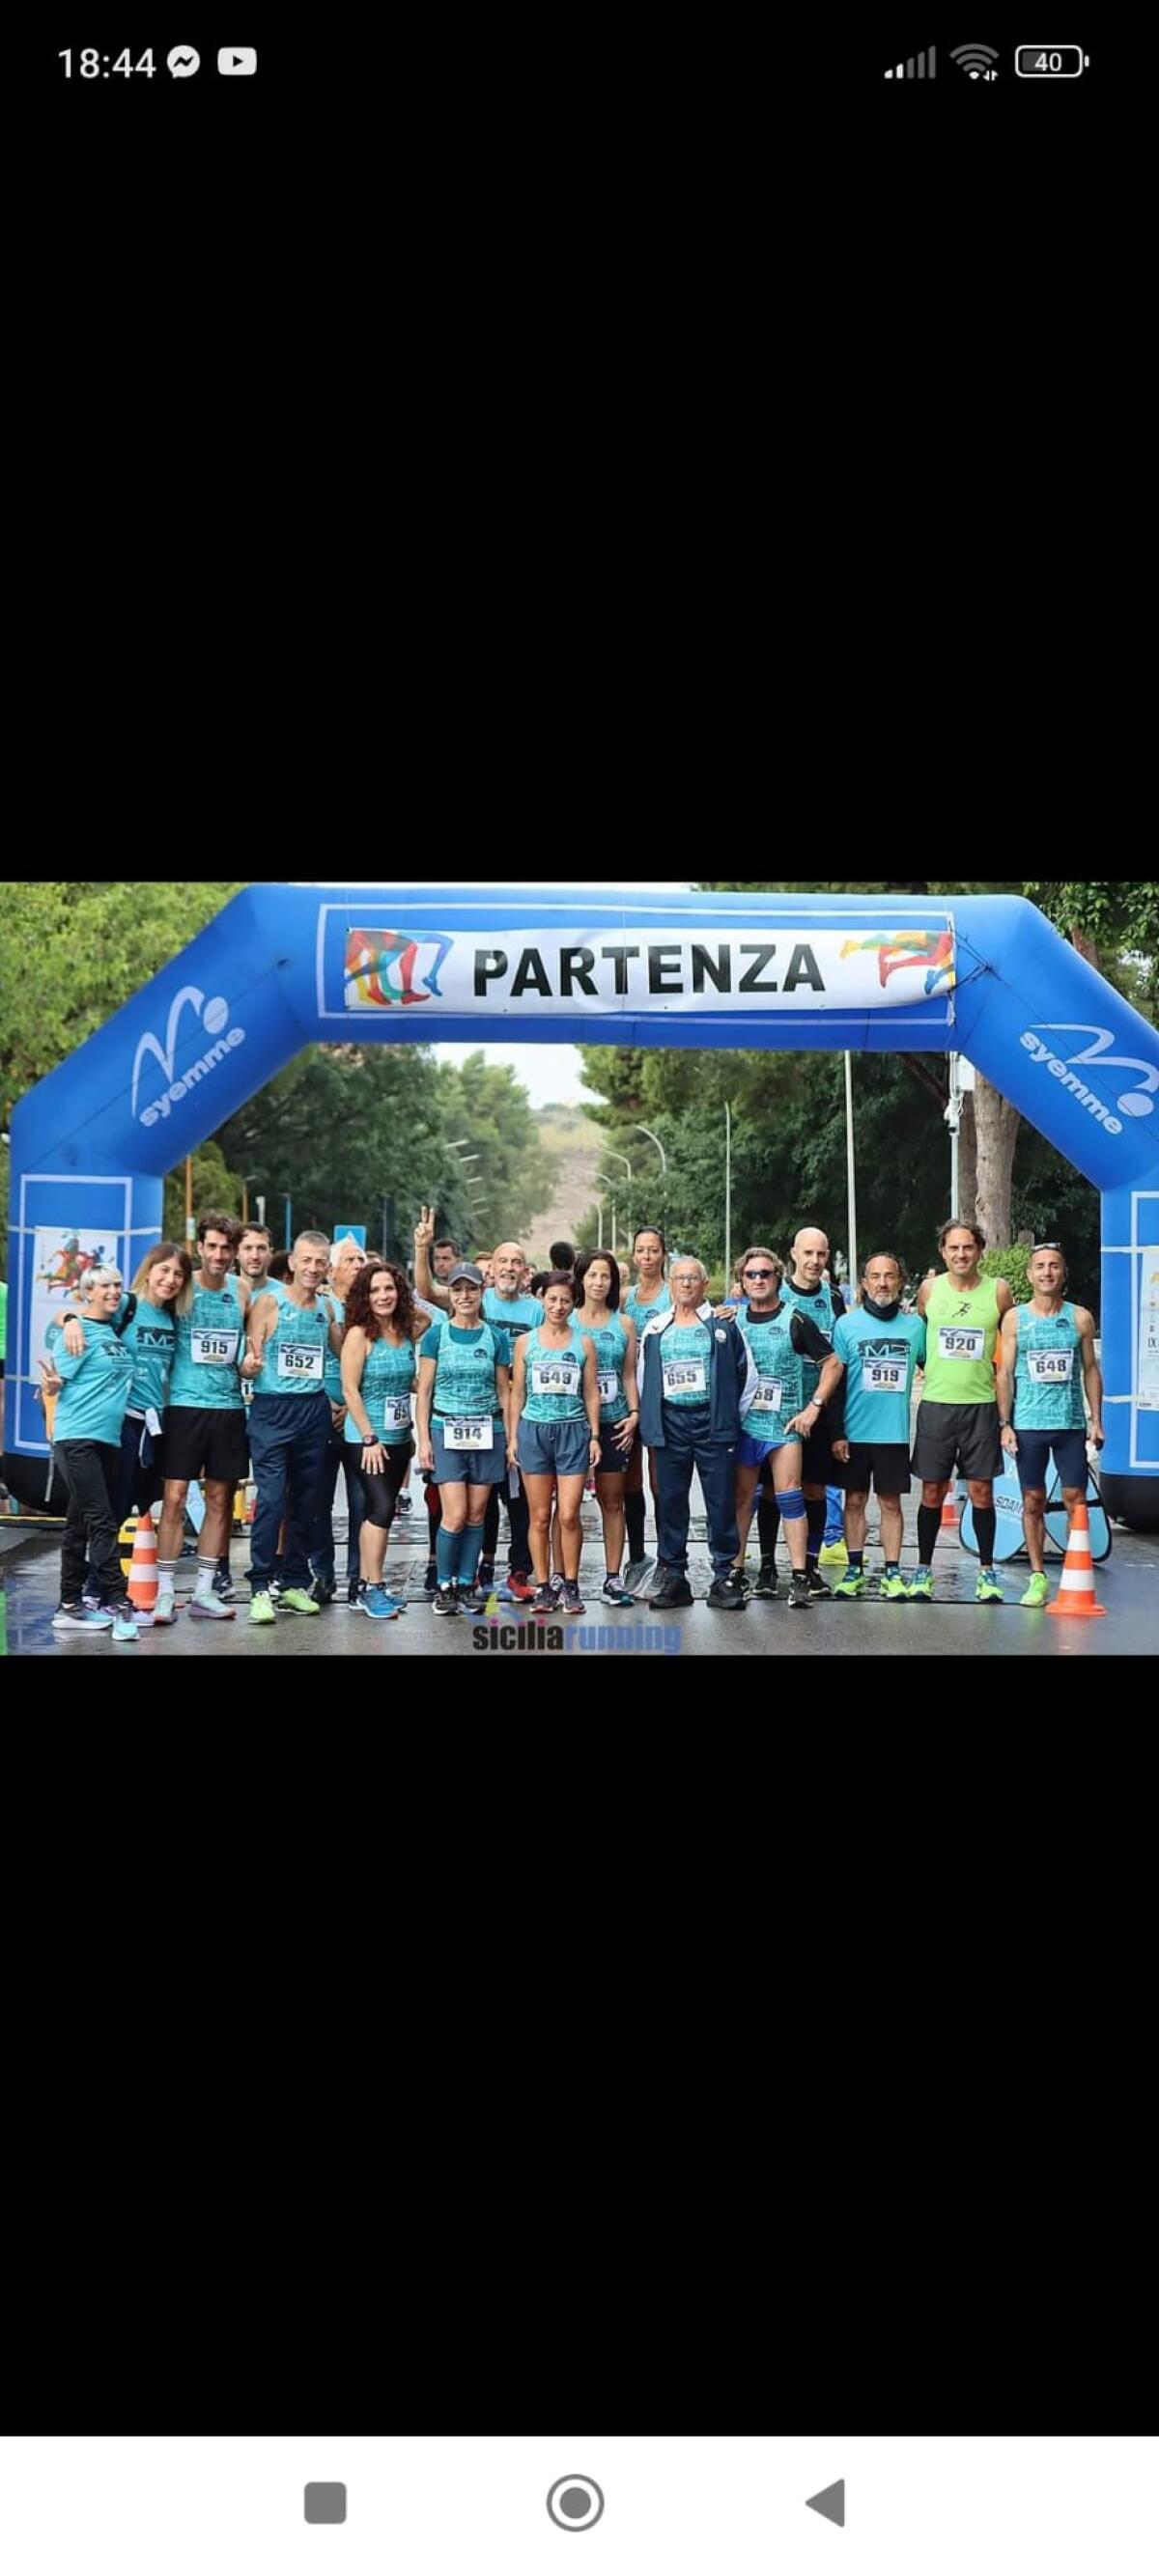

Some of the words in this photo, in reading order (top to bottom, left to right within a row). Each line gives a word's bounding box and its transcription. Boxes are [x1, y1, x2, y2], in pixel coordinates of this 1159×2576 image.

[58, 47, 157, 79] 18:44
[1033, 52, 1062, 71] 40
[473, 943, 826, 997] PARTENZA
[139, 1026, 246, 1128] syemme
[1019, 1031, 1122, 1134] syemme
[200, 1340, 229, 1355] 915
[945, 1336, 976, 1351] 920
[284, 1354, 315, 1369] 652
[1035, 1358, 1067, 1374] 648
[539, 1371, 572, 1385] 649
[666, 1370, 697, 1386] 655
[871, 1369, 899, 1383] 919
[453, 1427, 483, 1441] 914
